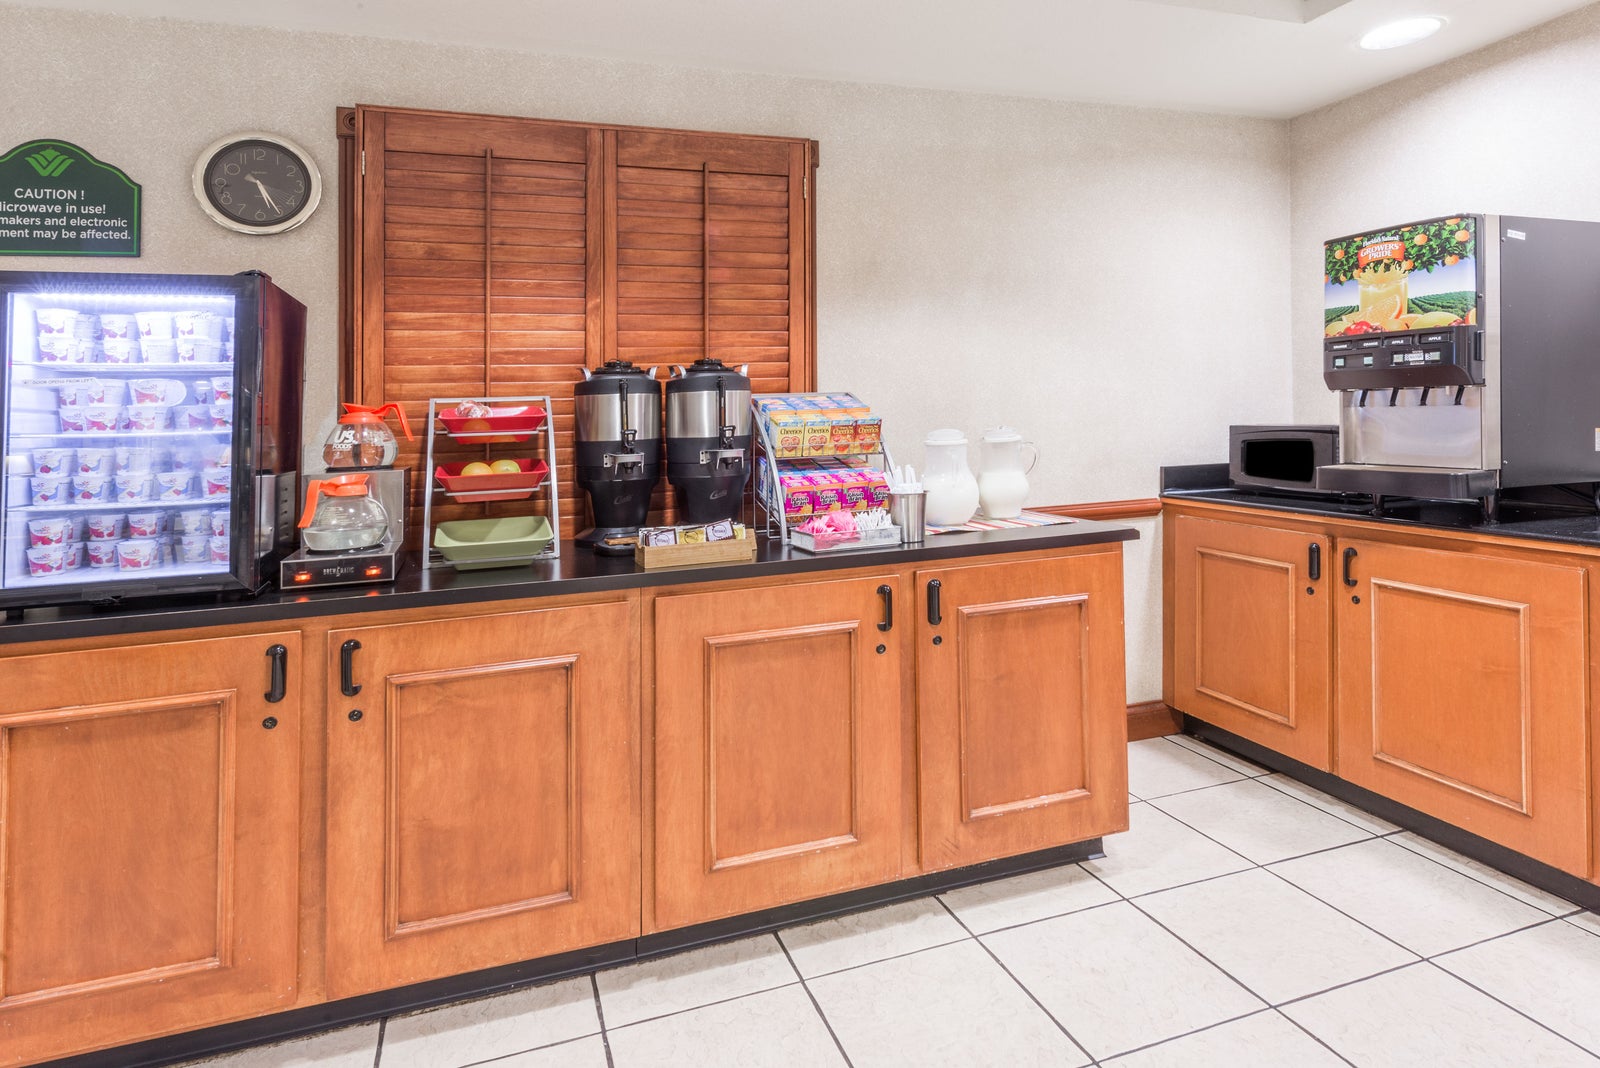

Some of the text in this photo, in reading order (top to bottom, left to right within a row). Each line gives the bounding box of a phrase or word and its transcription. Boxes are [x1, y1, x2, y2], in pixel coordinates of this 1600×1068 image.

[253, 148, 266, 161] 12
[223, 163, 241, 176] 10
[286, 165, 296, 177] 2
[215, 178, 226, 191] 9
[295, 180, 304, 193] 3
[14, 187, 77, 200] CAUTION
[221, 192, 232, 205] 8
[286, 195, 296, 207] 4
[0, 201, 106, 214] icrowave in use!
[237, 203, 247, 215] 7
[255, 209, 266, 221] 6
[44, 216, 66, 226] and
[70, 217, 128, 227] electronic
[33, 230, 58, 240] may
[62, 229, 77, 239] be
[80, 229, 131, 240] affected.
[1368, 250, 1392, 260] PRIDE
